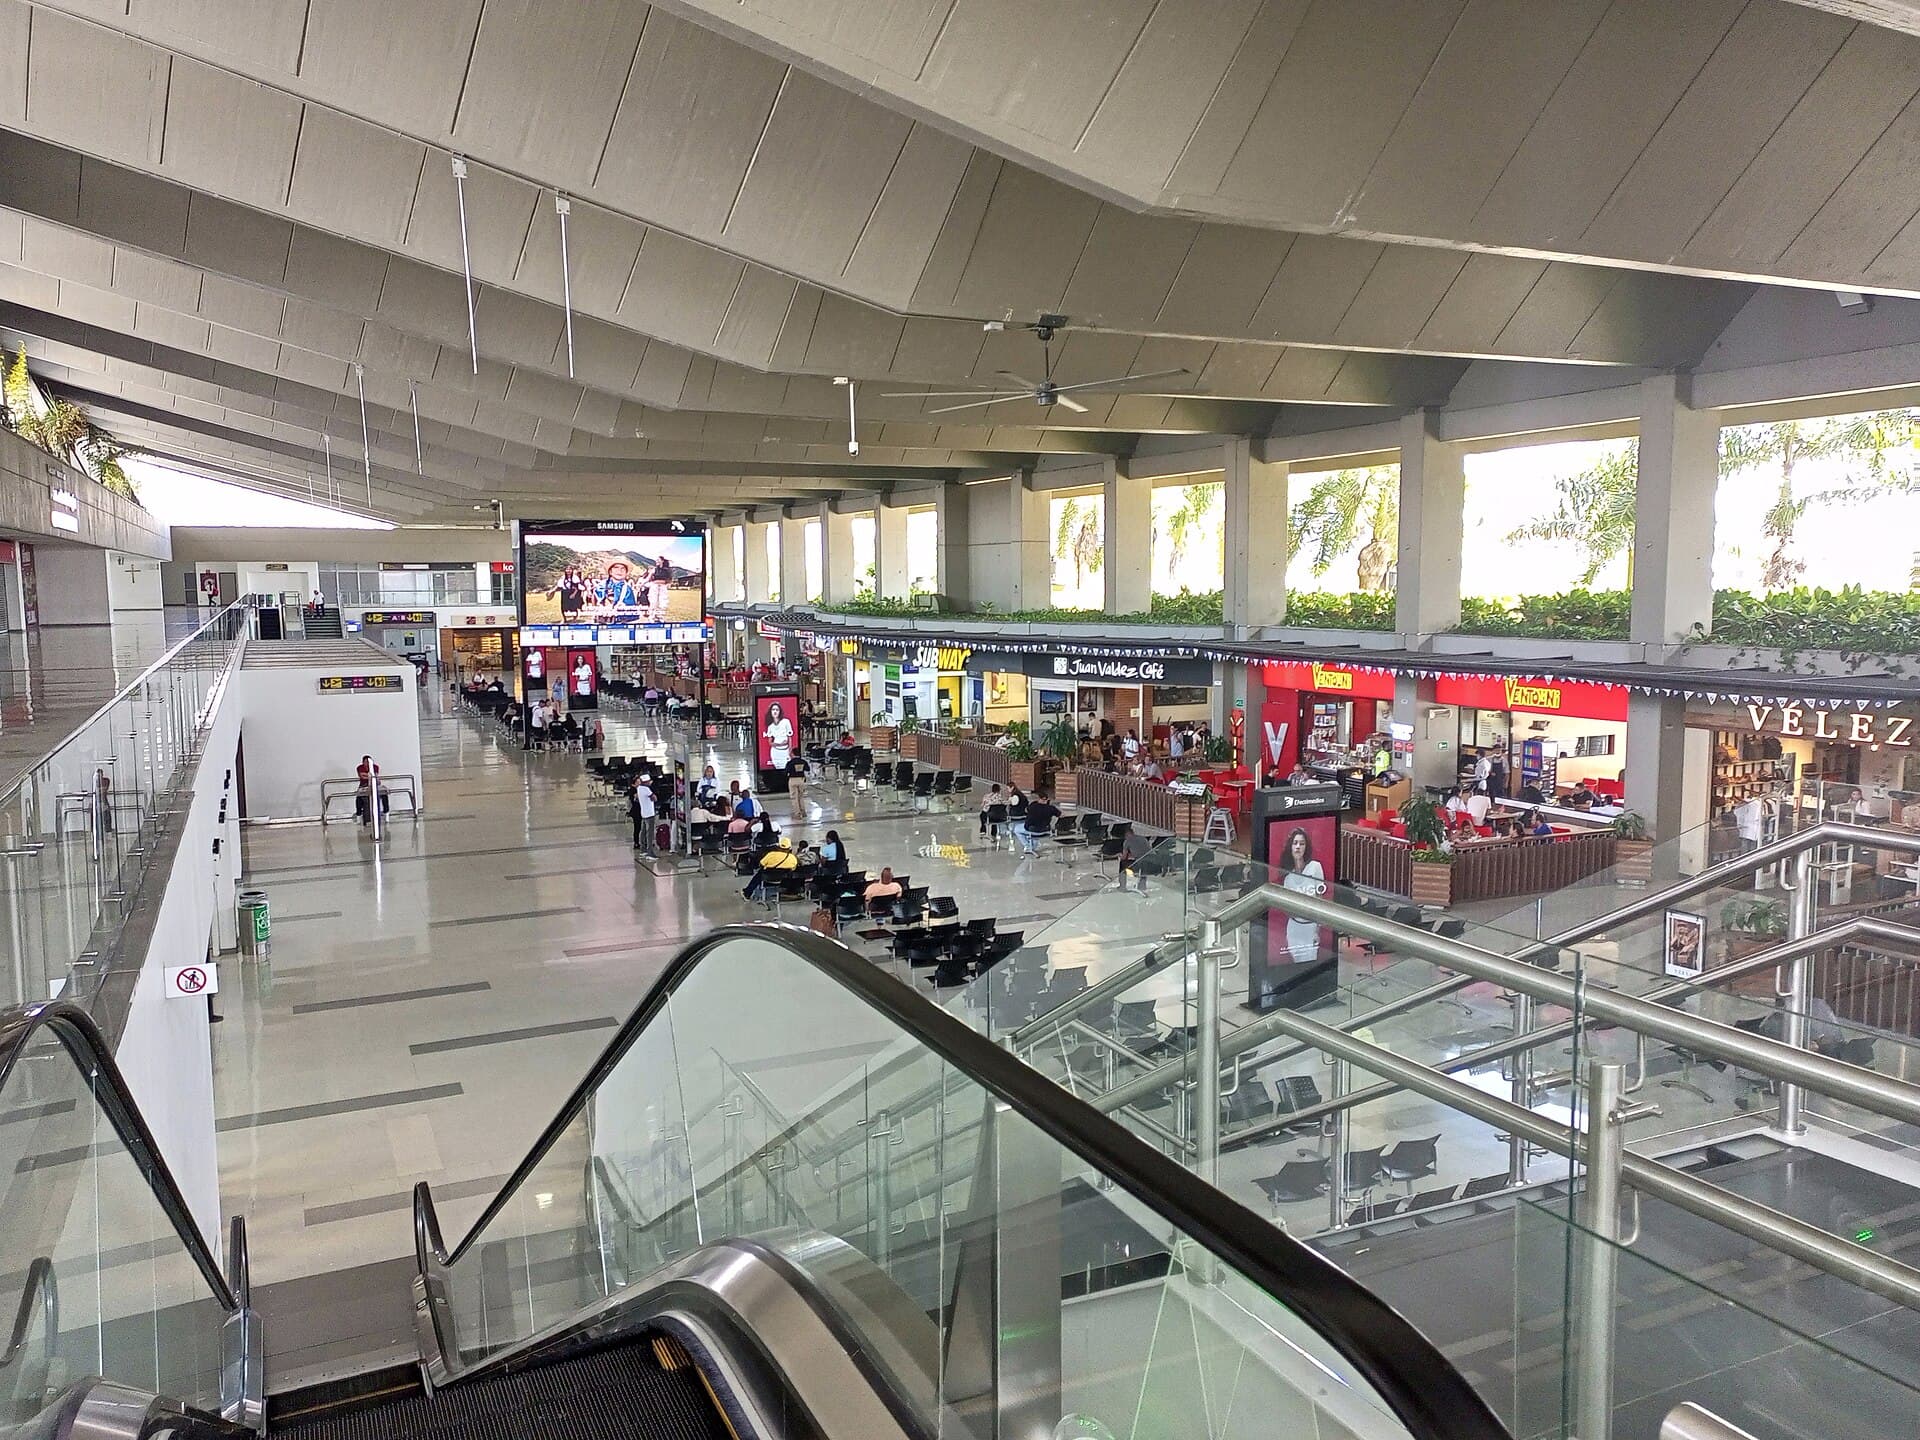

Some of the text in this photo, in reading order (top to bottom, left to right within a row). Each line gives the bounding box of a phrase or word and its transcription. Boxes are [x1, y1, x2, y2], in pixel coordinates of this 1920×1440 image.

[597, 522, 634, 530] SAMSUNG
[912, 646, 971, 671] SUBWAY
[1069, 659, 1165, 680] Juan Valdez Café
[1747, 701, 1913, 747] VÉLEZ
[1263, 721, 1289, 766] V
